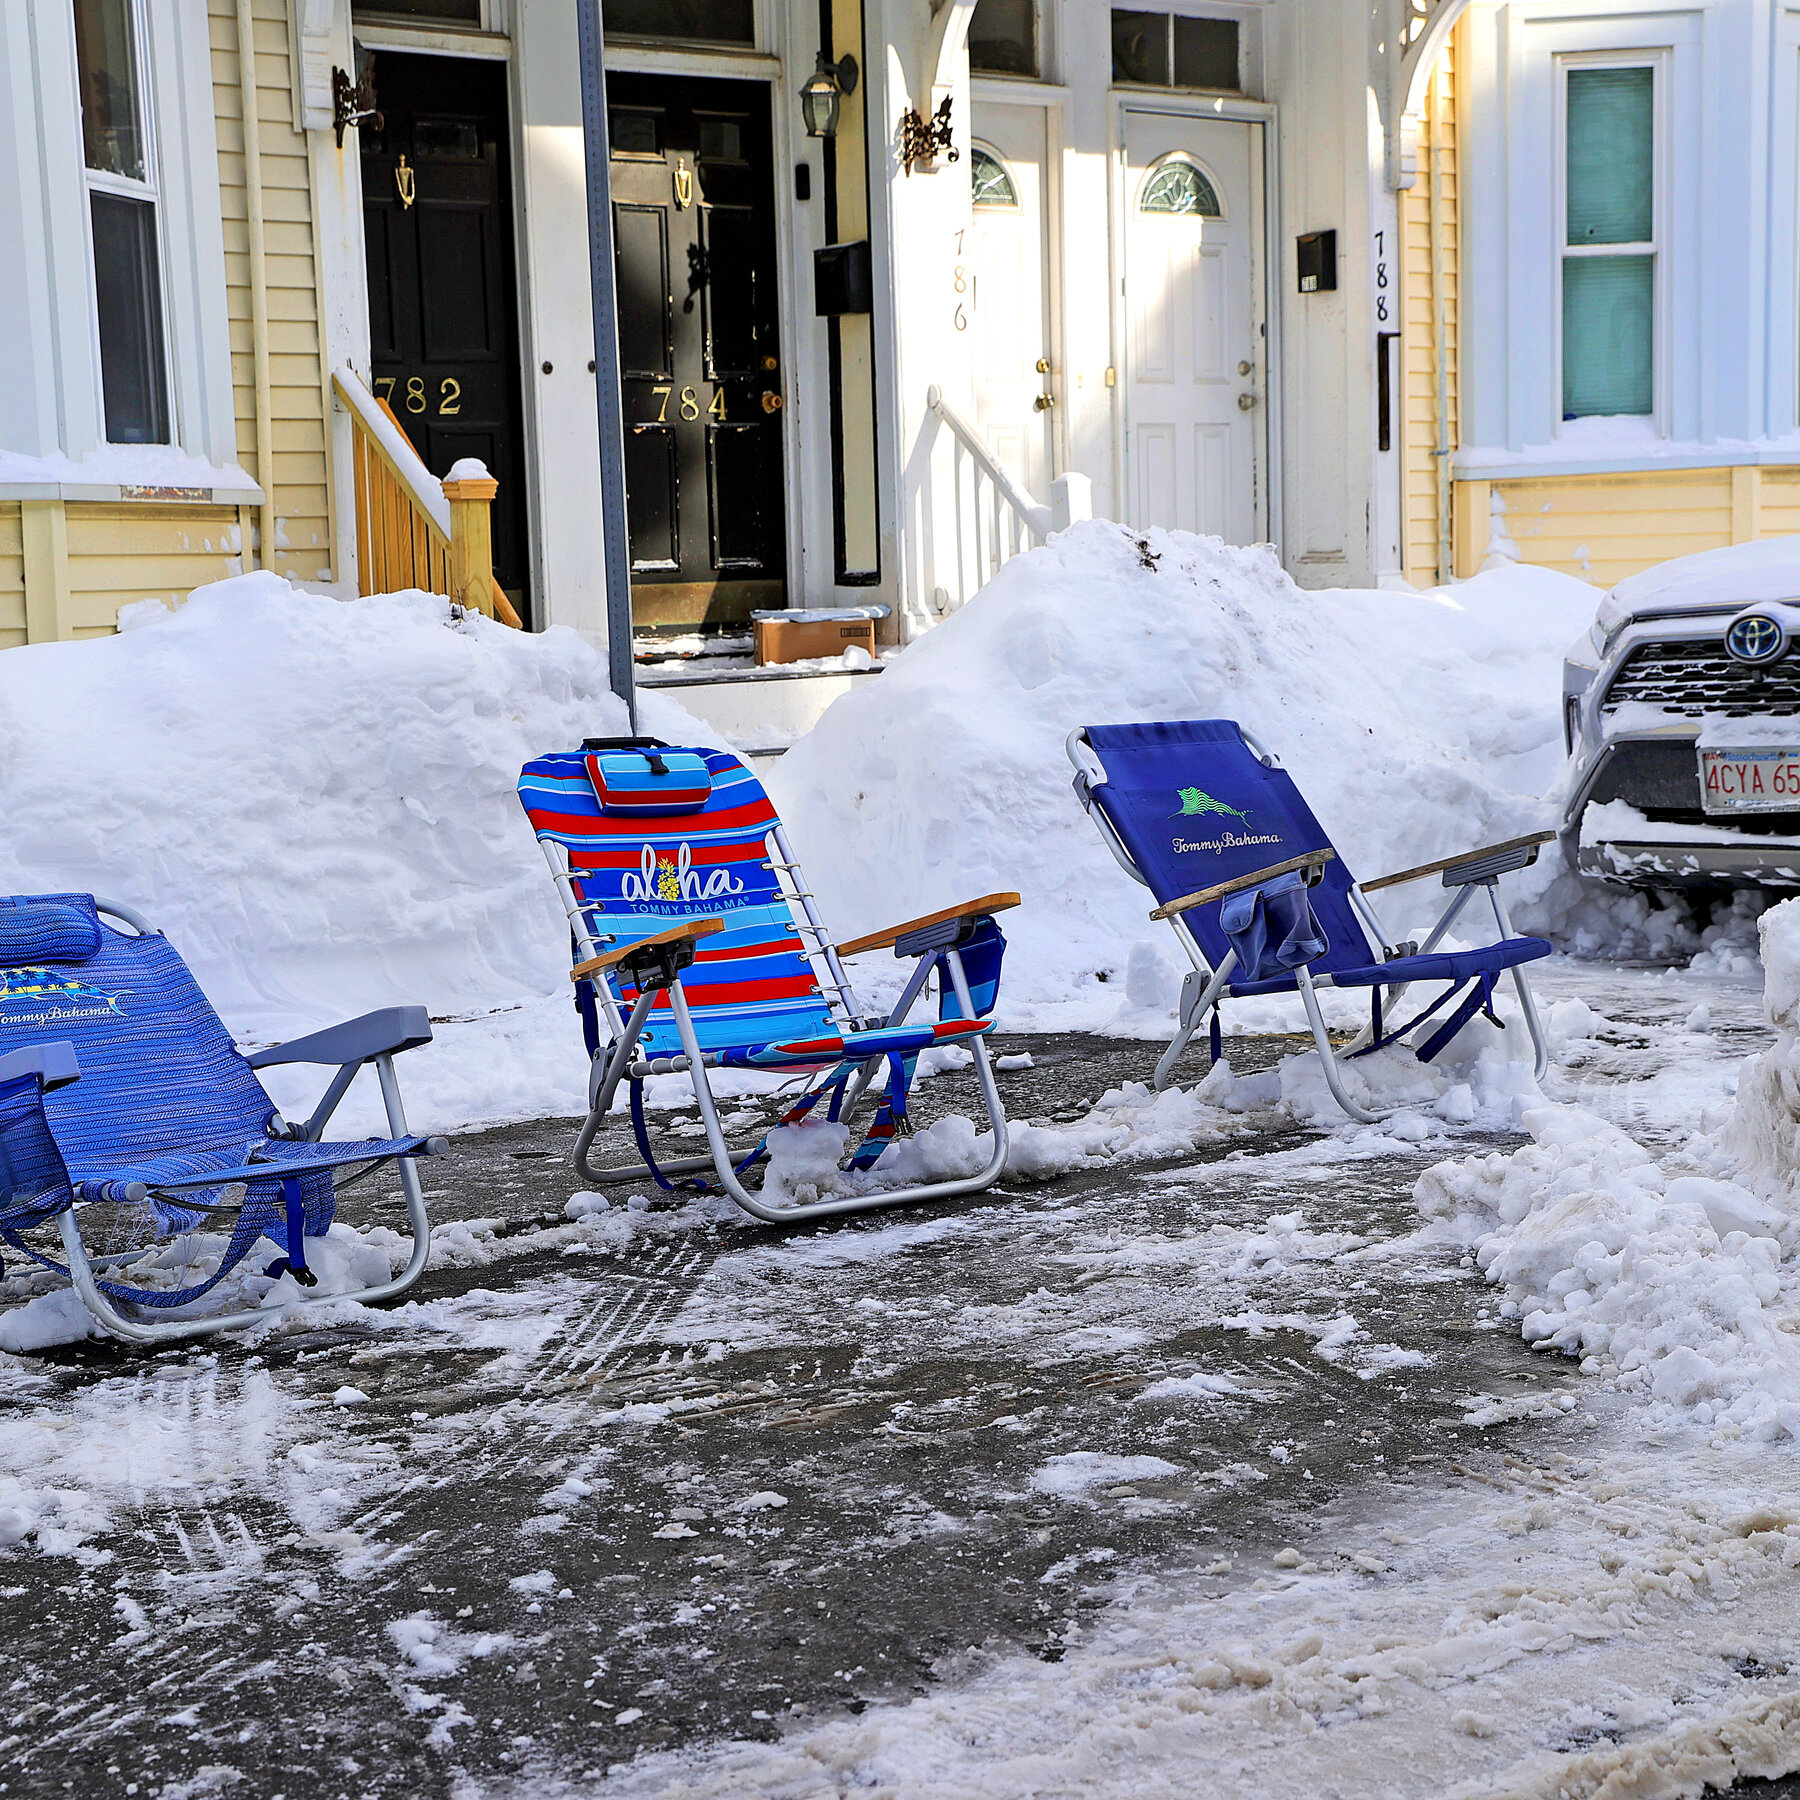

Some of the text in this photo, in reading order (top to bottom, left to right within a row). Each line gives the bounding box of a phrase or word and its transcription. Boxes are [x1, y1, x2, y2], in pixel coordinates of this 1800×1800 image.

[953, 228, 967, 332] 786
[1374, 230, 1388, 322] 788
[374, 376, 461, 415] 782
[651, 385, 729, 422] 784
[1707, 763, 1800, 795] 4CYA 65
[1171, 837, 1223, 855] Tommy
[621, 841, 745, 902] aloha
[629, 903, 680, 916] TOMMY
[47, 1005, 112, 1020] Bahama
